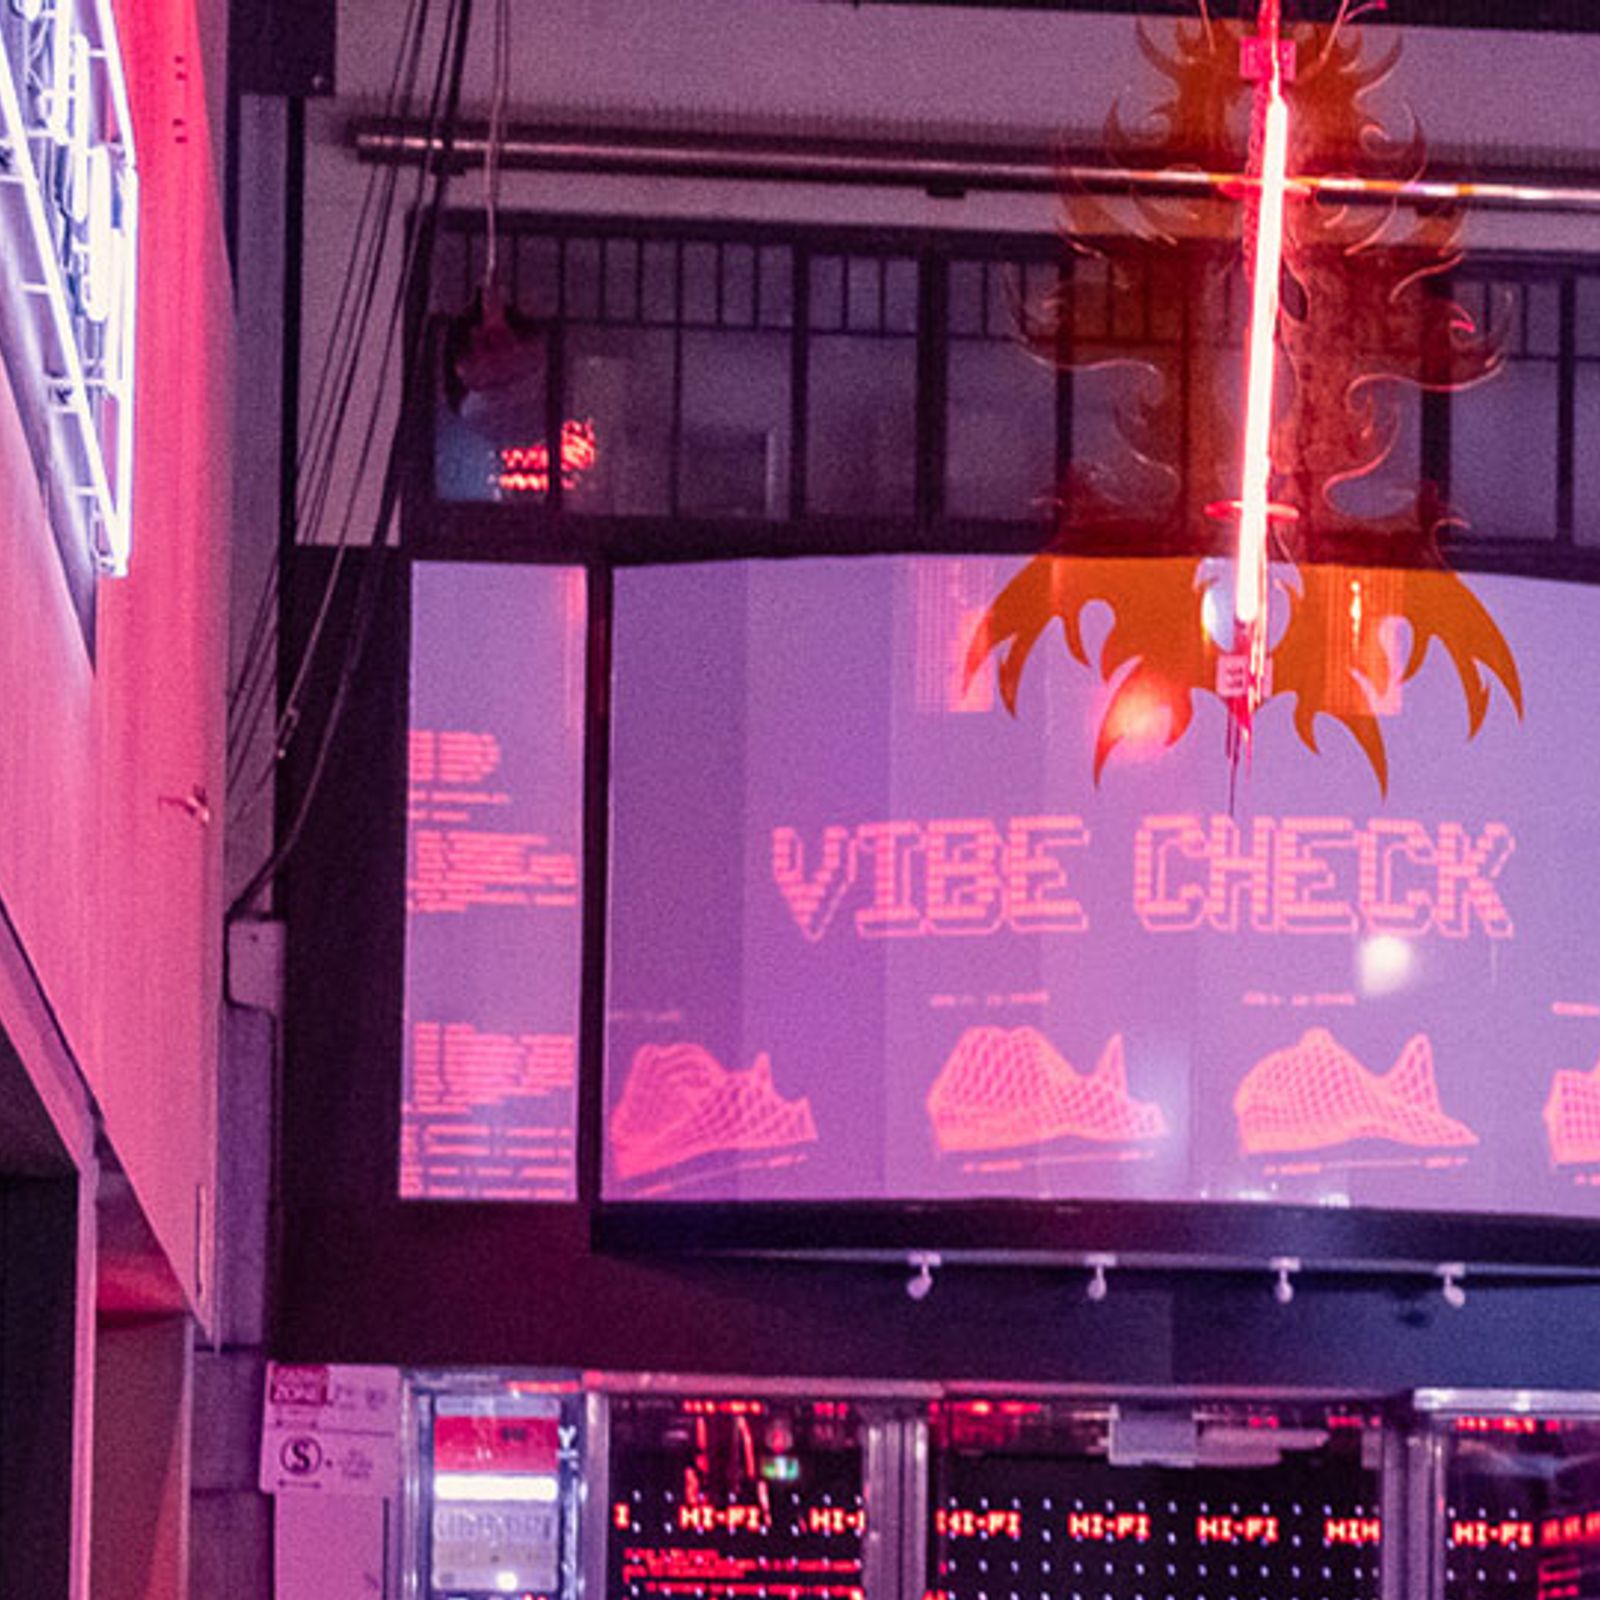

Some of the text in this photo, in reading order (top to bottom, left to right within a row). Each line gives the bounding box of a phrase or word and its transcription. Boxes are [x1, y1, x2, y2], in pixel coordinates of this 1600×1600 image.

[771, 814, 1517, 942] VIBE CHECK
[1066, 1512, 1151, 1541] HI-FI
[1196, 1515, 1279, 1543] HI-FI
[1452, 1519, 1535, 1548] HI-FI
